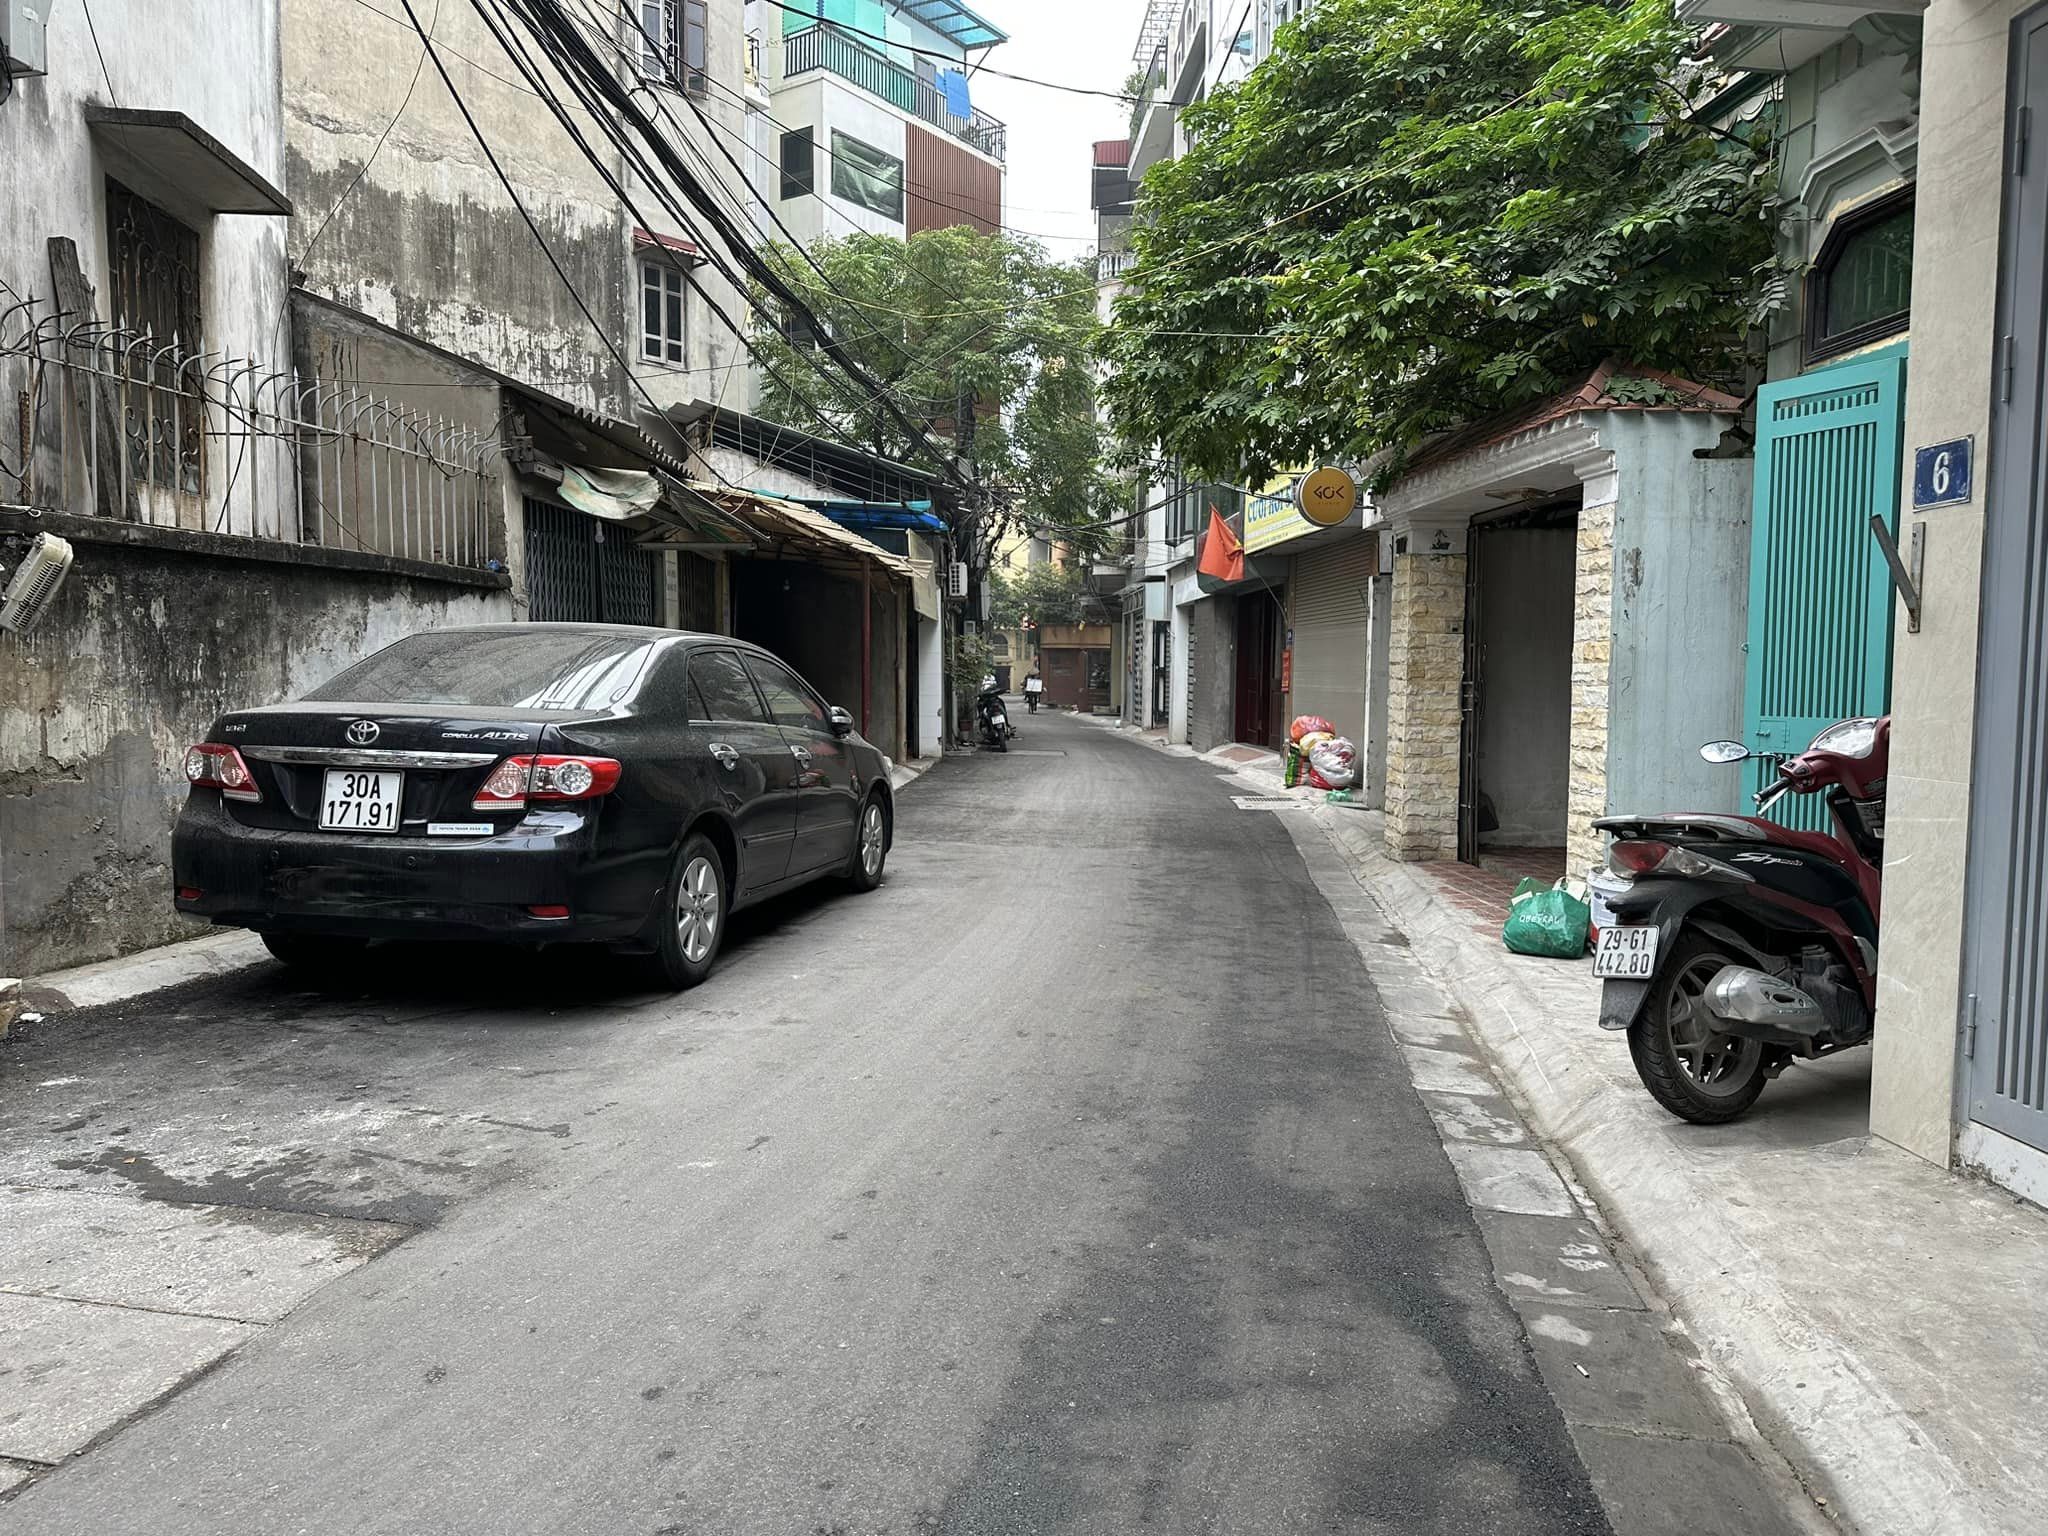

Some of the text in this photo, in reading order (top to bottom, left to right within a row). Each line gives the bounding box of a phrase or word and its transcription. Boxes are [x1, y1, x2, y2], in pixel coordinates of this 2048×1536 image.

[1932, 451, 1949, 494] 6
[480, 731, 530, 741] ALTIS
[342, 773, 381, 799] 30A
[327, 800, 393, 827] 171.91
[1596, 953, 1650, 974] 442.80
